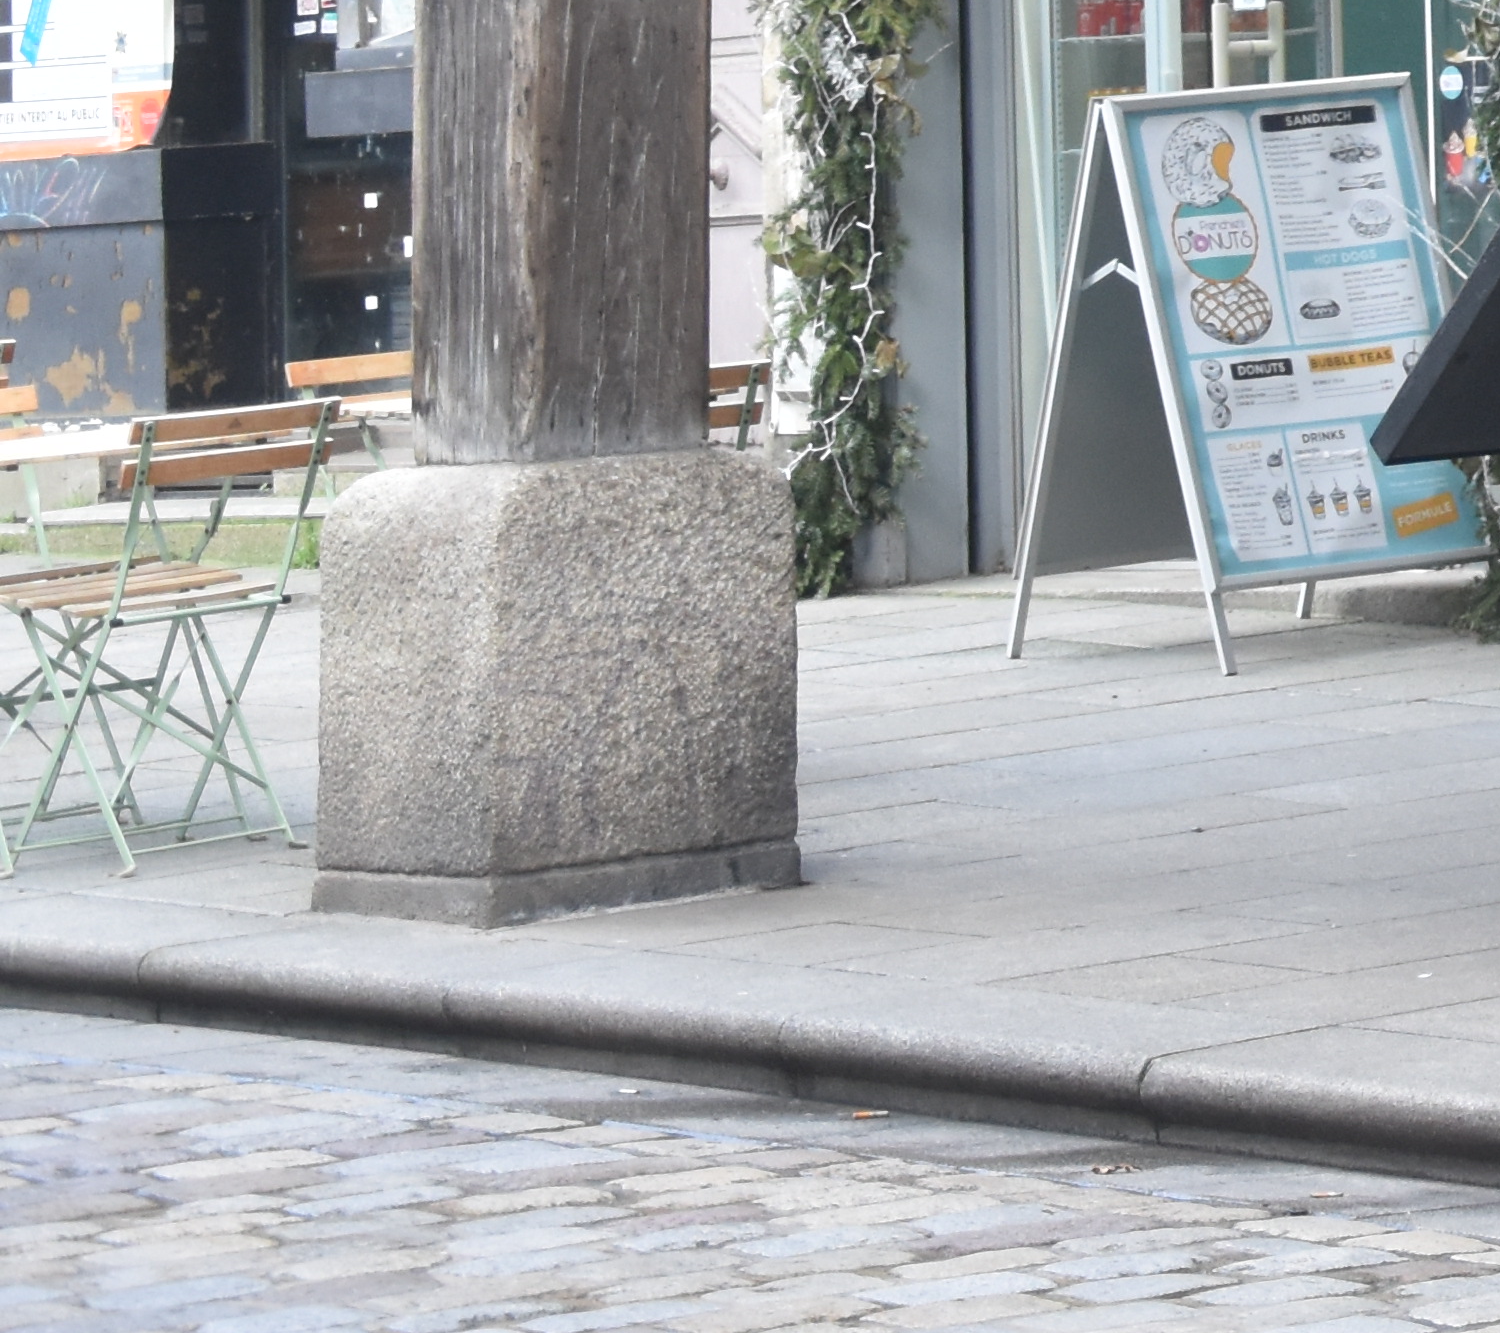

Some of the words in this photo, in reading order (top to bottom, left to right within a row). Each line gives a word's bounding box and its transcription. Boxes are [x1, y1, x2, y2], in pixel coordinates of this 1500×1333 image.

[1284, 110, 1352, 127] SANDWICH
[1177, 229, 1254, 255] DONUTS
[1341, 249, 1377, 263] DOGS
[1311, 352, 1356, 369] BUBBLE
[1359, 349, 1393, 364] TEAS
[1236, 361, 1286, 377] DONUTS
[1302, 429, 1346, 444] DRINKS
[1397, 501, 1454, 527] FORMULE
